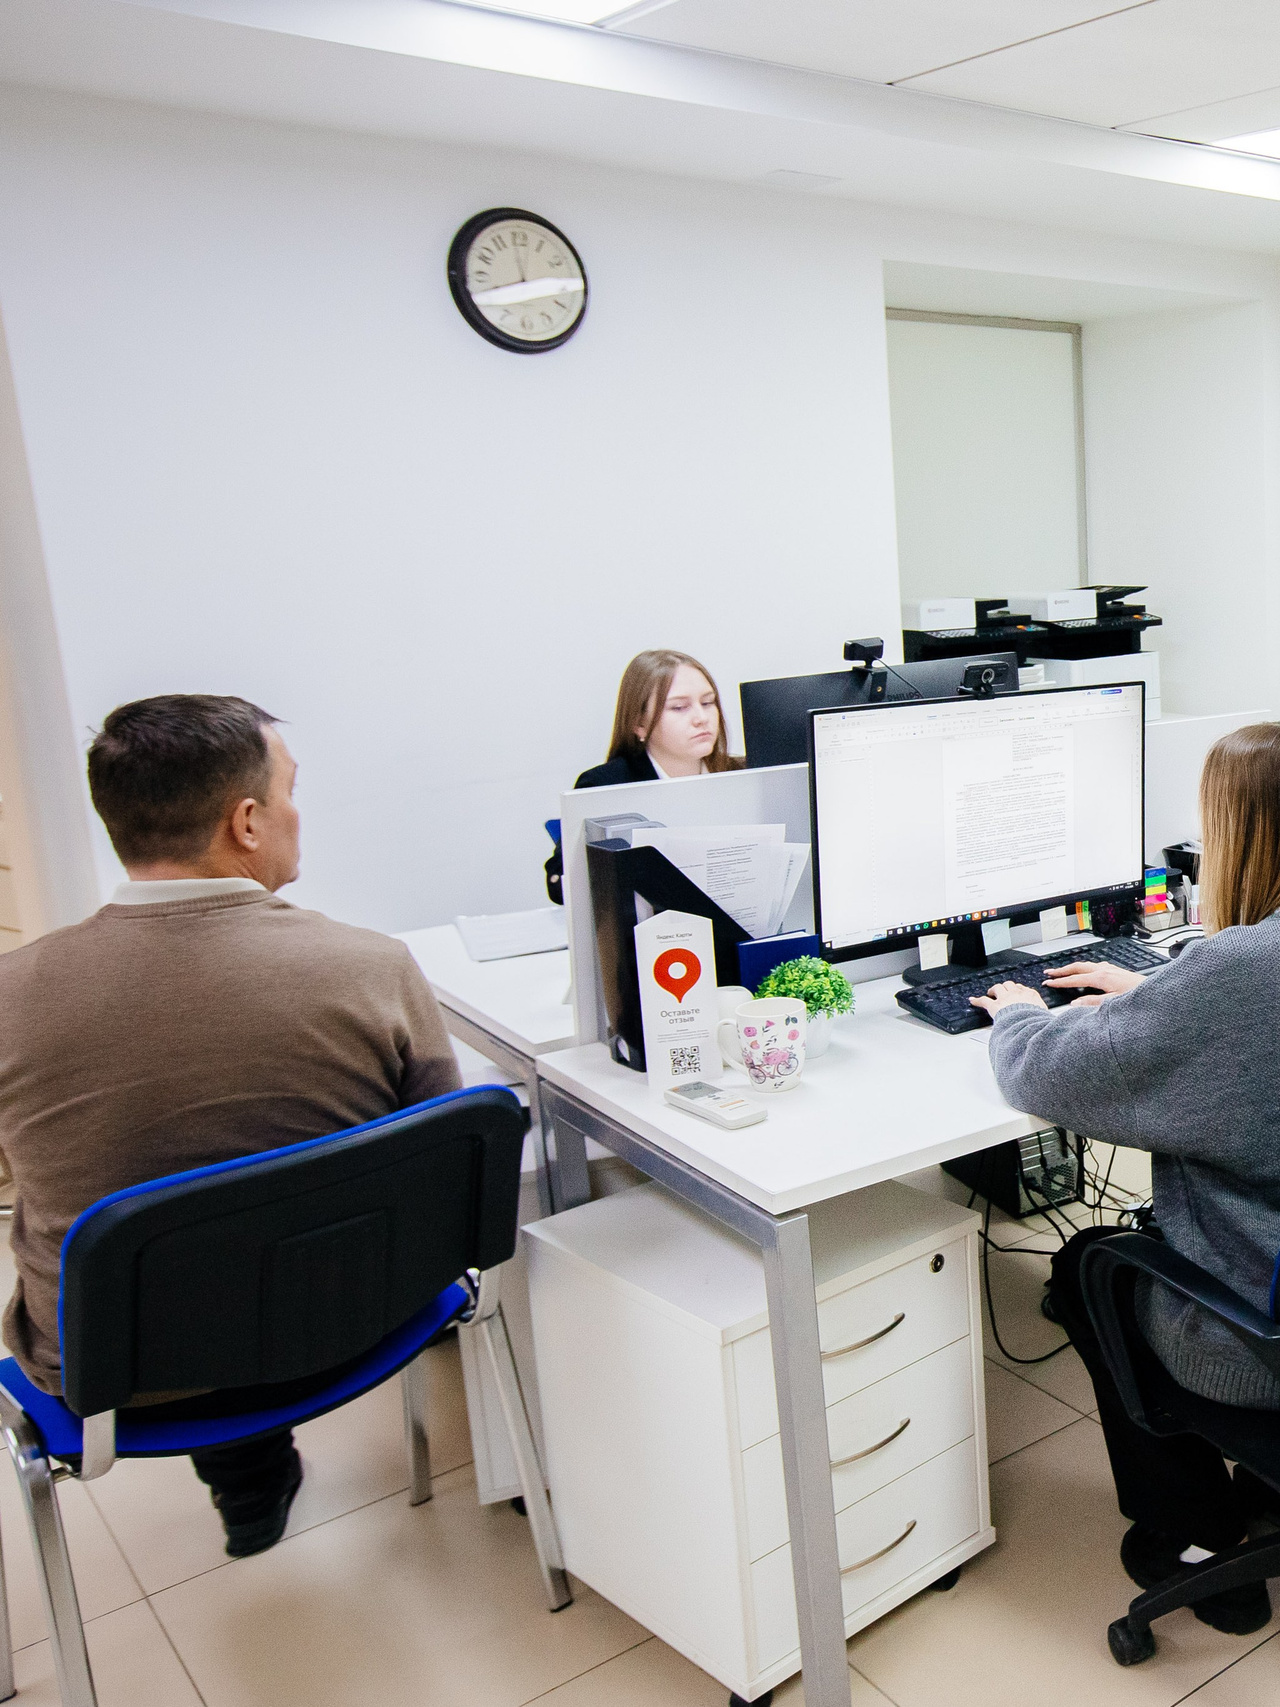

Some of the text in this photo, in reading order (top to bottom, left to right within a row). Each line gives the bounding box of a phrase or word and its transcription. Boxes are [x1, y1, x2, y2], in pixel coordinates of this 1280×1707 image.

[491, 234, 508, 251] 11
[510, 231, 529, 247] 12
[535, 239, 545, 253] 1
[476, 246, 496, 266] 10
[473, 270, 491, 283] 9
[887, 691, 921, 701] PHILIPS
[660, 1008, 701, 1018] Оставьте
[669, 1016, 695, 1025] отзыв
